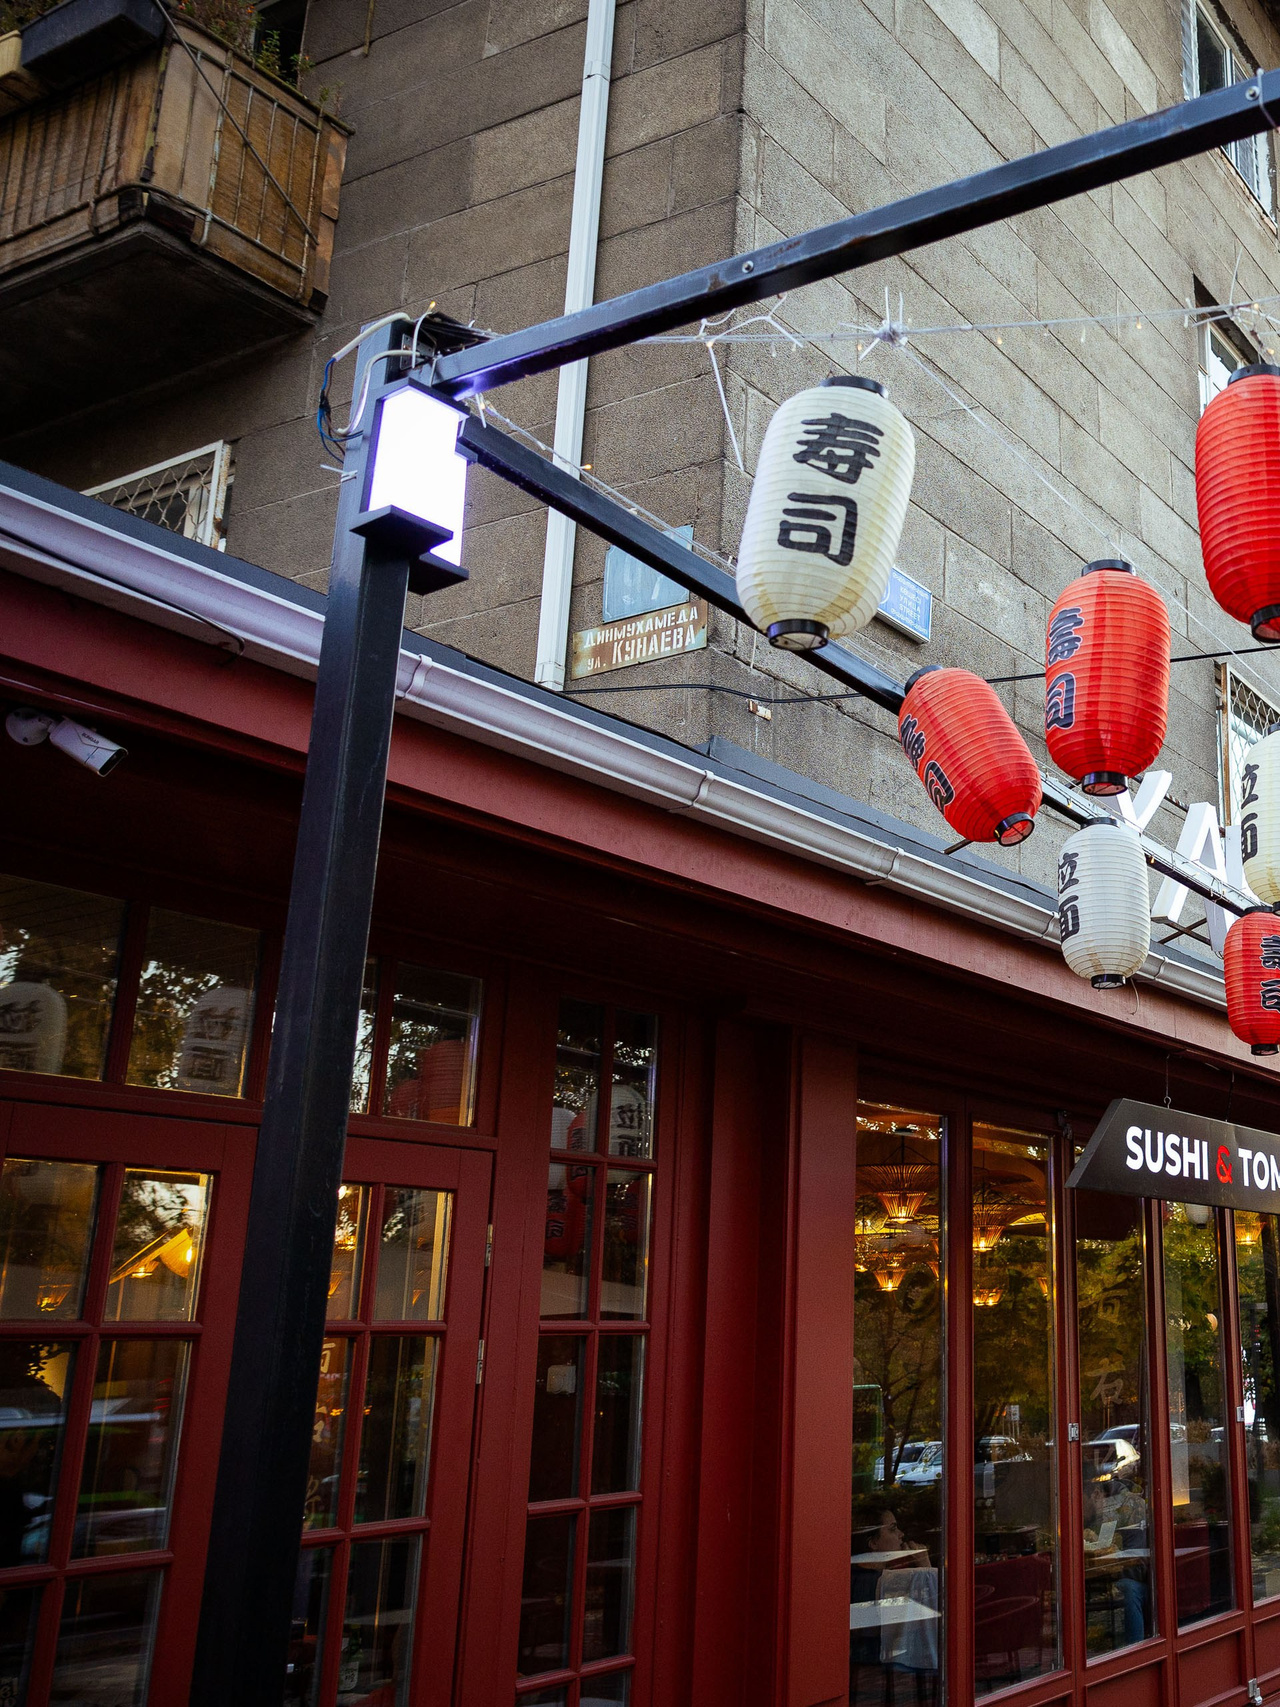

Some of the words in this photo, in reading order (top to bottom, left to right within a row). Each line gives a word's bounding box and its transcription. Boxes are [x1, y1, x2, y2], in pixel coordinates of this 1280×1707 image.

[583, 606, 699, 649] ДИНМУХАМЕДА
[611, 624, 696, 665] КУНАЕВА
[1125, 1125, 1209, 1181] SUSHI
[1215, 1145, 1233, 1185] &
